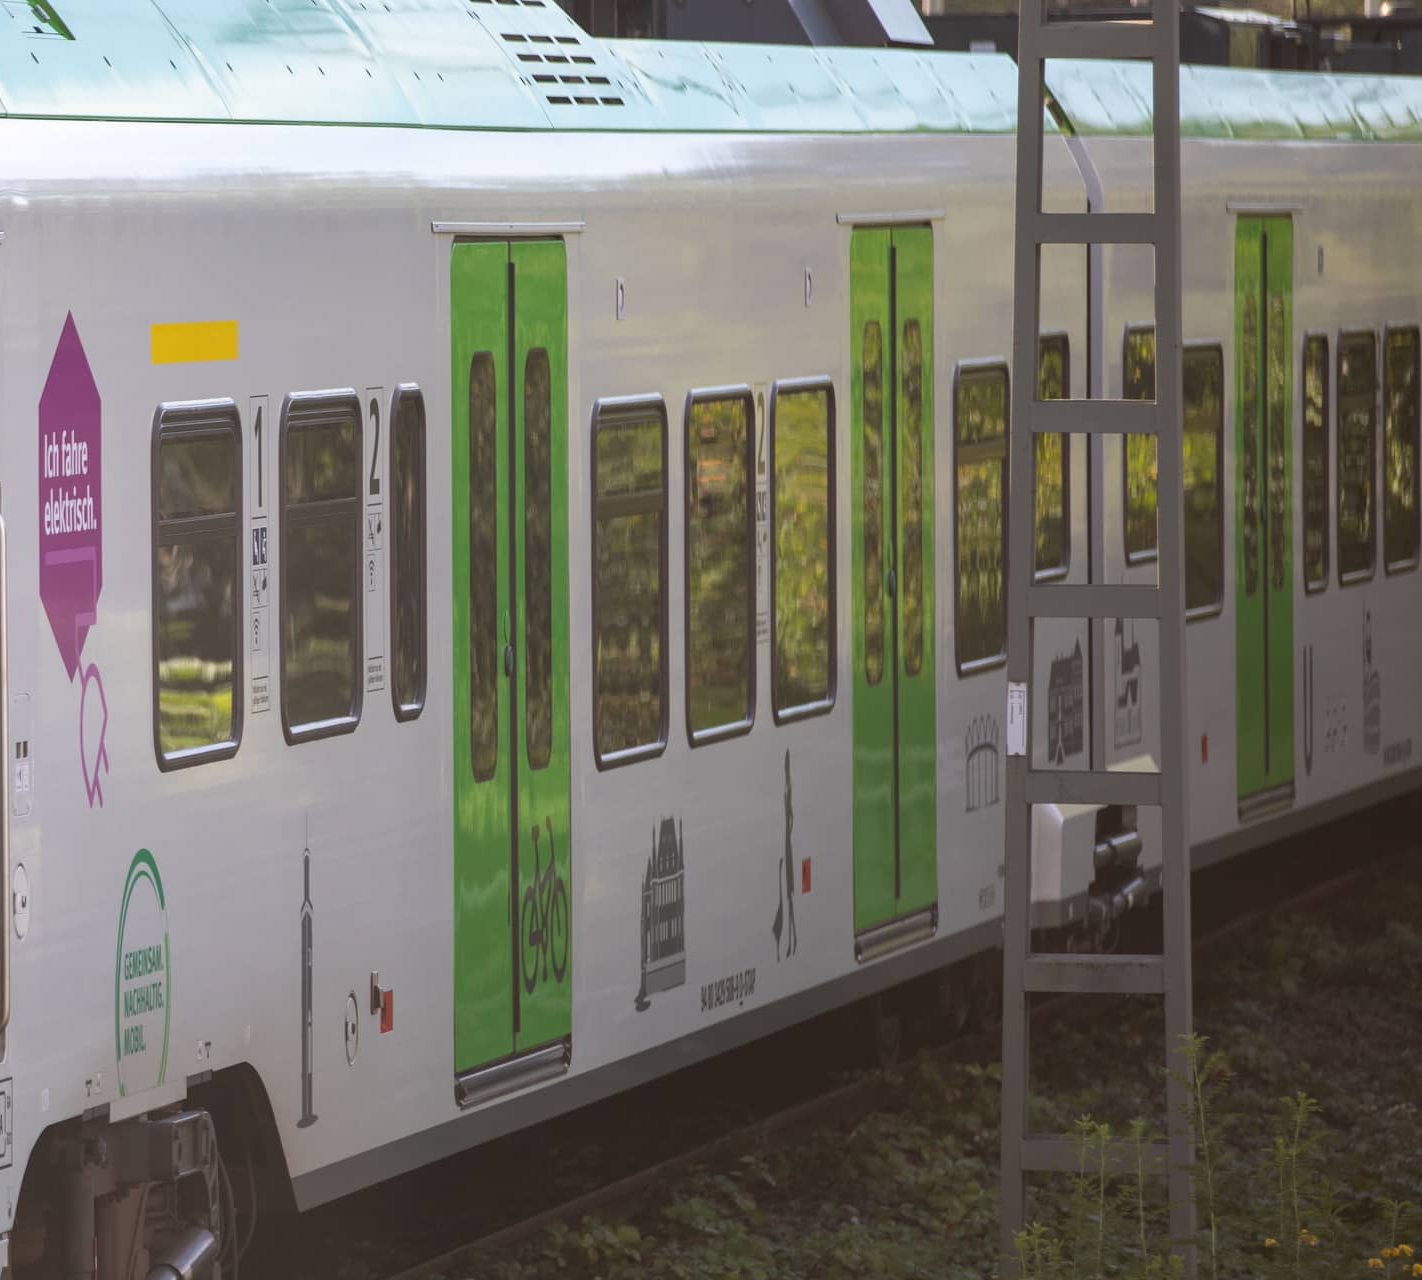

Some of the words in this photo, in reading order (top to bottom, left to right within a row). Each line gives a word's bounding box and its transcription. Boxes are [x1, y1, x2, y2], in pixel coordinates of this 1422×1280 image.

[44, 431, 59, 478] Ich
[61, 429, 88, 477] fahre
[254, 405, 262, 508] 1
[369, 397, 380, 495] 2
[758, 391, 766, 475] 2
[44, 484, 97, 536] elektrisch.
[124, 944, 164, 981] GEMEINSAM.
[123, 981, 164, 1018] NACHHALTIG.
[123, 1023, 146, 1056] MOBIL.
